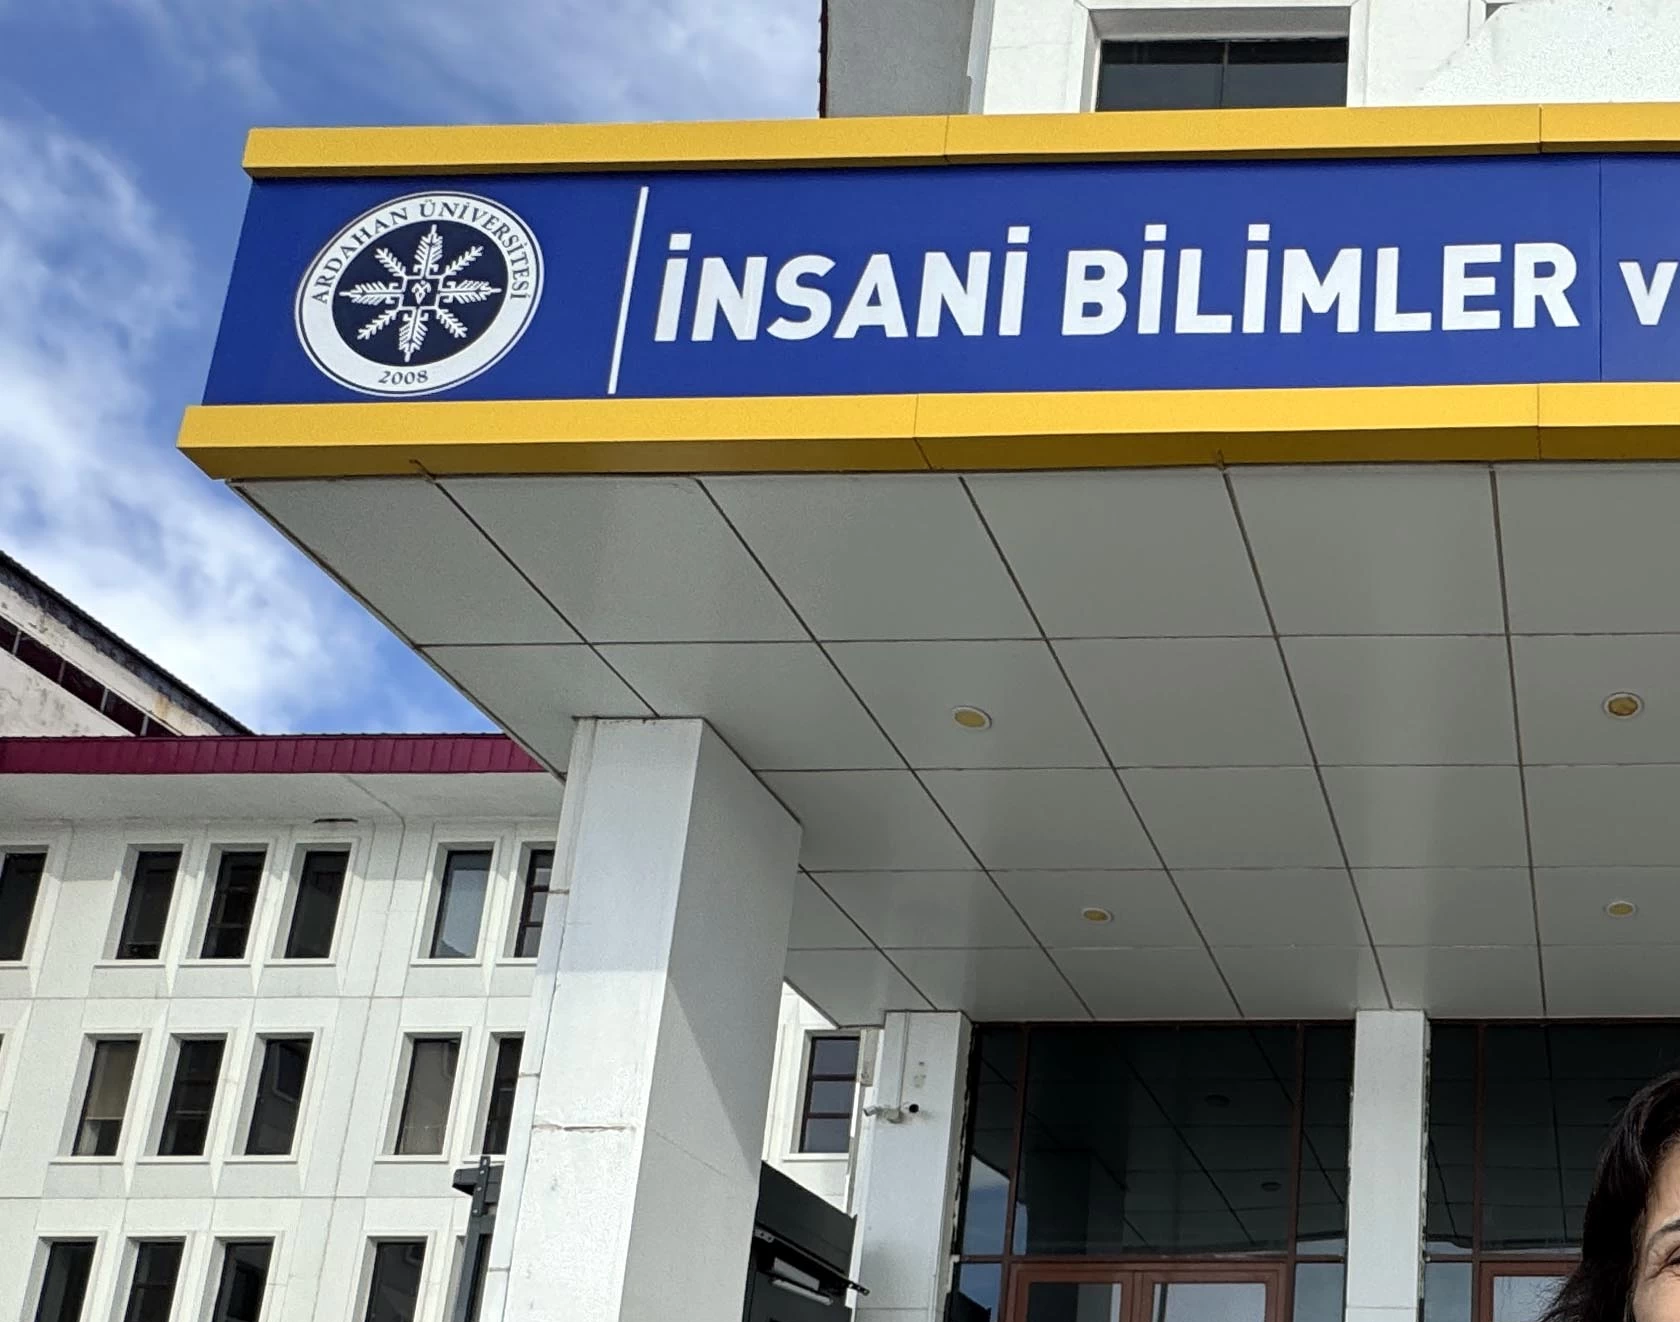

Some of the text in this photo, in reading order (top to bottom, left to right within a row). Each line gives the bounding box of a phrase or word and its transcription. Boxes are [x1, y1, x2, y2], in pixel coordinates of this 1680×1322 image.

[311, 199, 530, 304] ARDAHAN ÜNİVERSİTESİ
[655, 227, 1029, 341] İNSANİ
[1062, 224, 1579, 335] BİLİMLER
[378, 370, 429, 385] 2008
